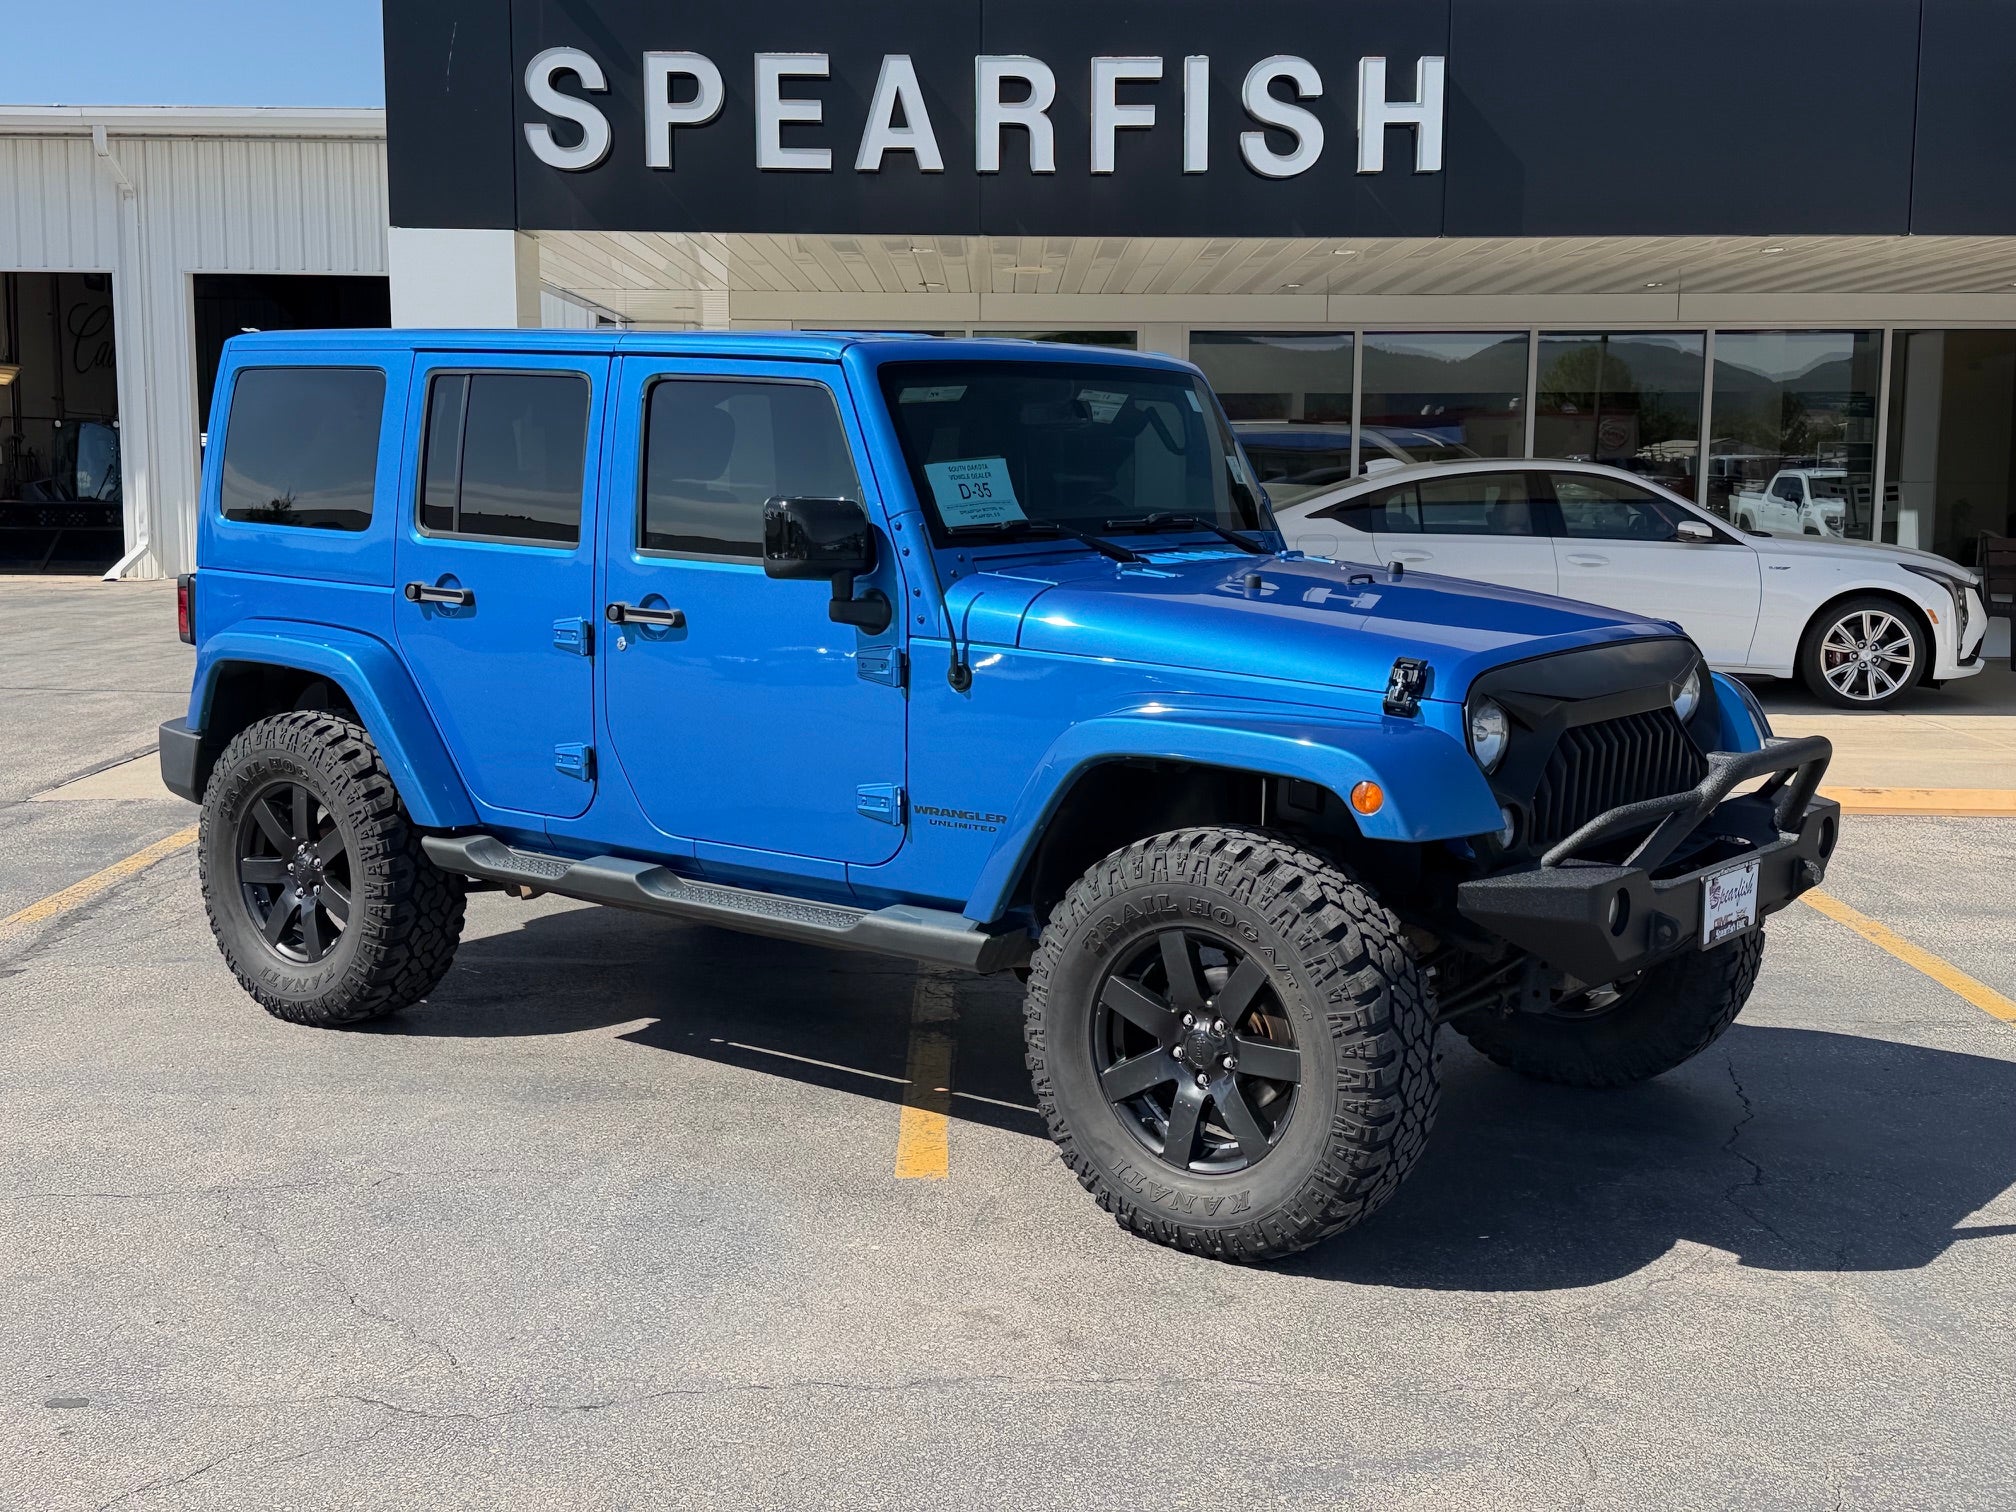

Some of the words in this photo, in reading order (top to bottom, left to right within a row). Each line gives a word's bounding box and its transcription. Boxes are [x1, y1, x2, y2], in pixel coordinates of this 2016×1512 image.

[522, 46, 1447, 179] SPEARFISH
[970, 472, 992, 480] DEALER
[958, 482, 992, 499] D-35
[913, 805, 1007, 824] WRANGLER
[929, 819, 997, 832] UNLIMITED
[1081, 893, 1178, 953] TRAIL
[1187, 895, 1260, 942] HOG
[1109, 1158, 1252, 1217] KANATI
